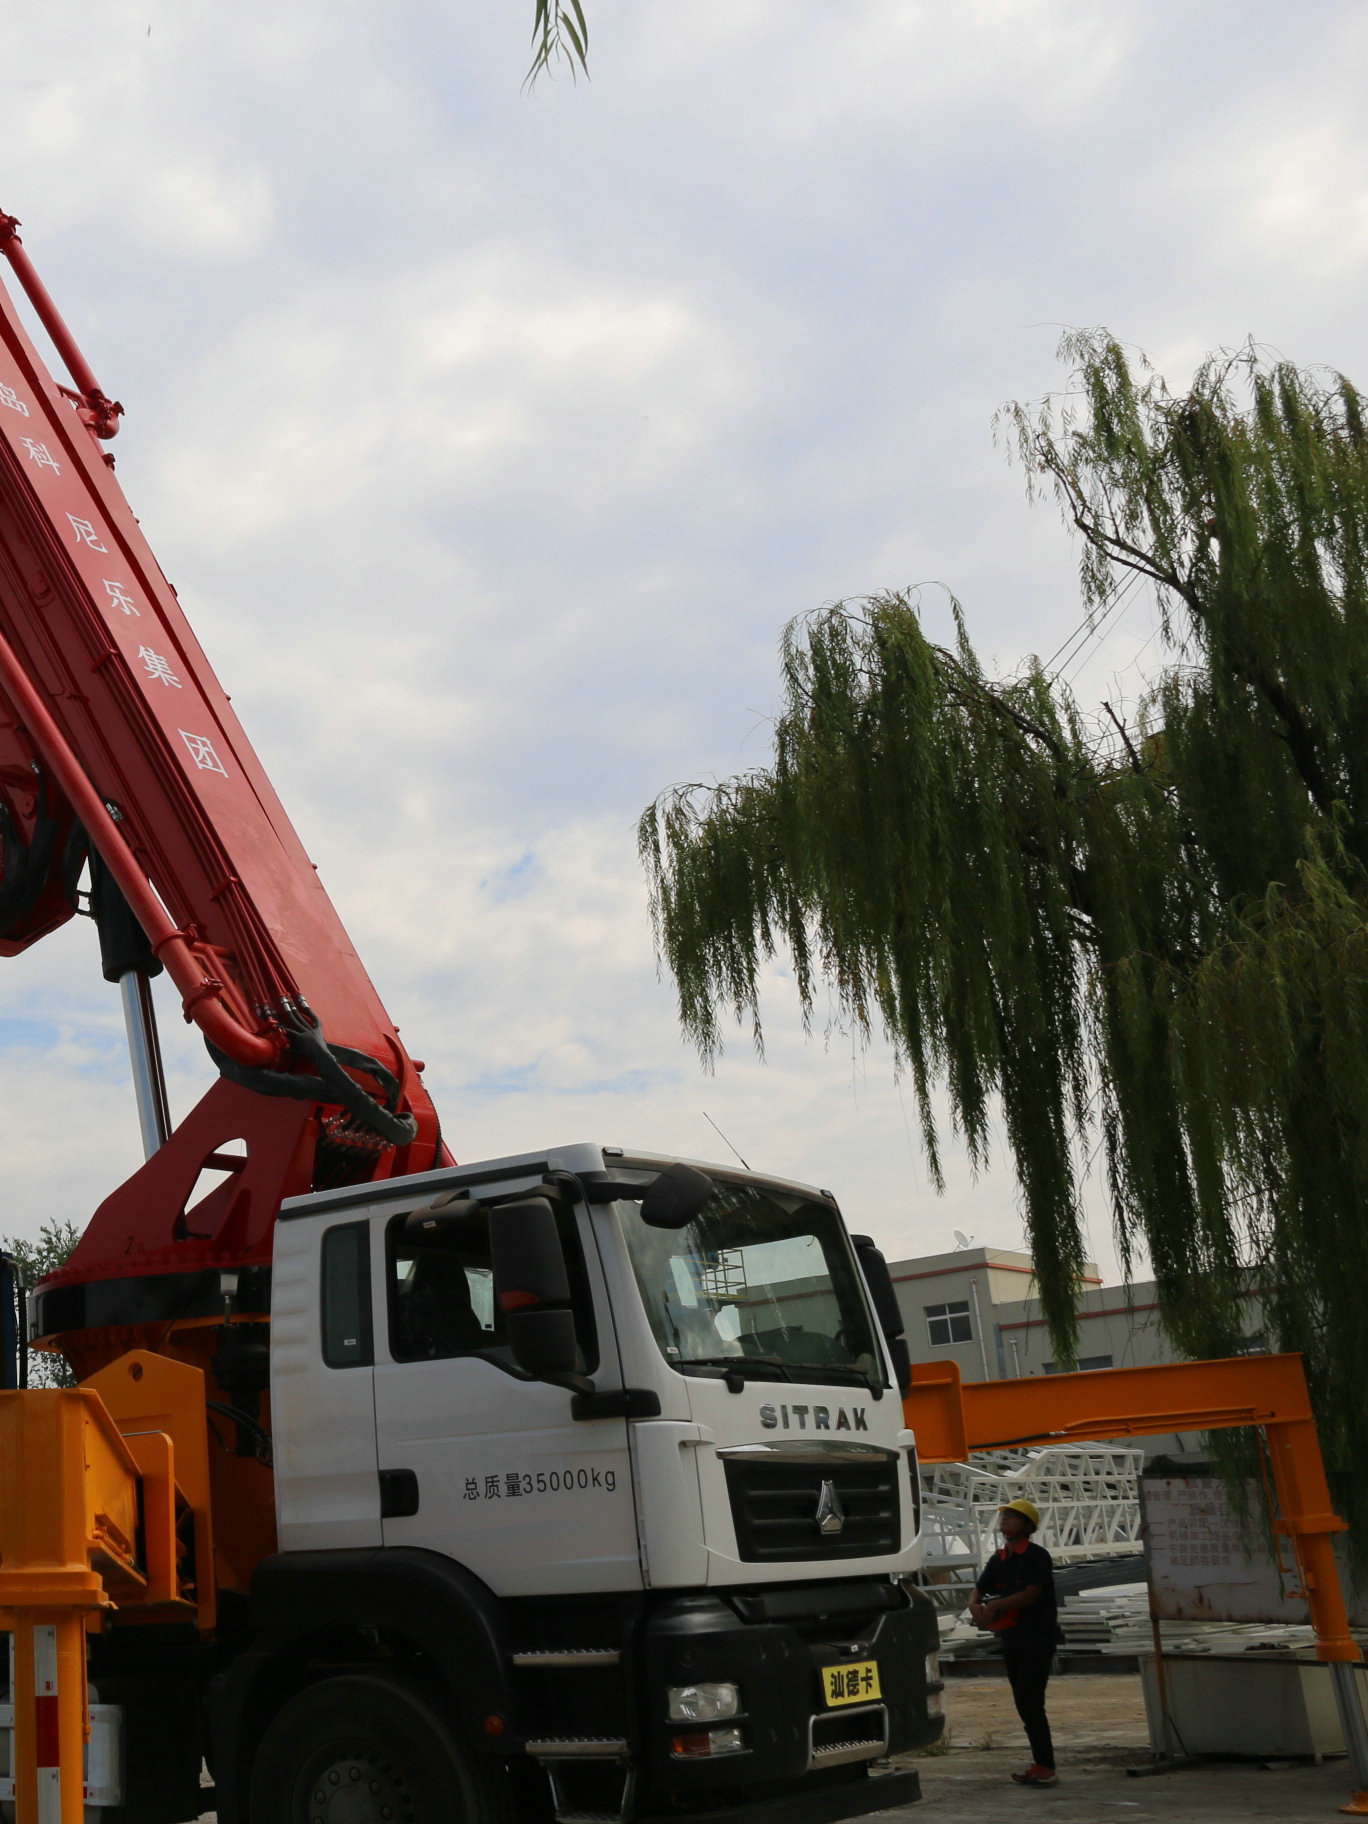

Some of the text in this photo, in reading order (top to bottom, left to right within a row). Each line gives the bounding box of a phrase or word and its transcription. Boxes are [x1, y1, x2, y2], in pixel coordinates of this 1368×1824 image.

[759, 1403, 868, 1431] SITRAK
[462, 1467, 616, 1501] 总质量35000kg
[830, 1666, 874, 1700] 汕德卡
